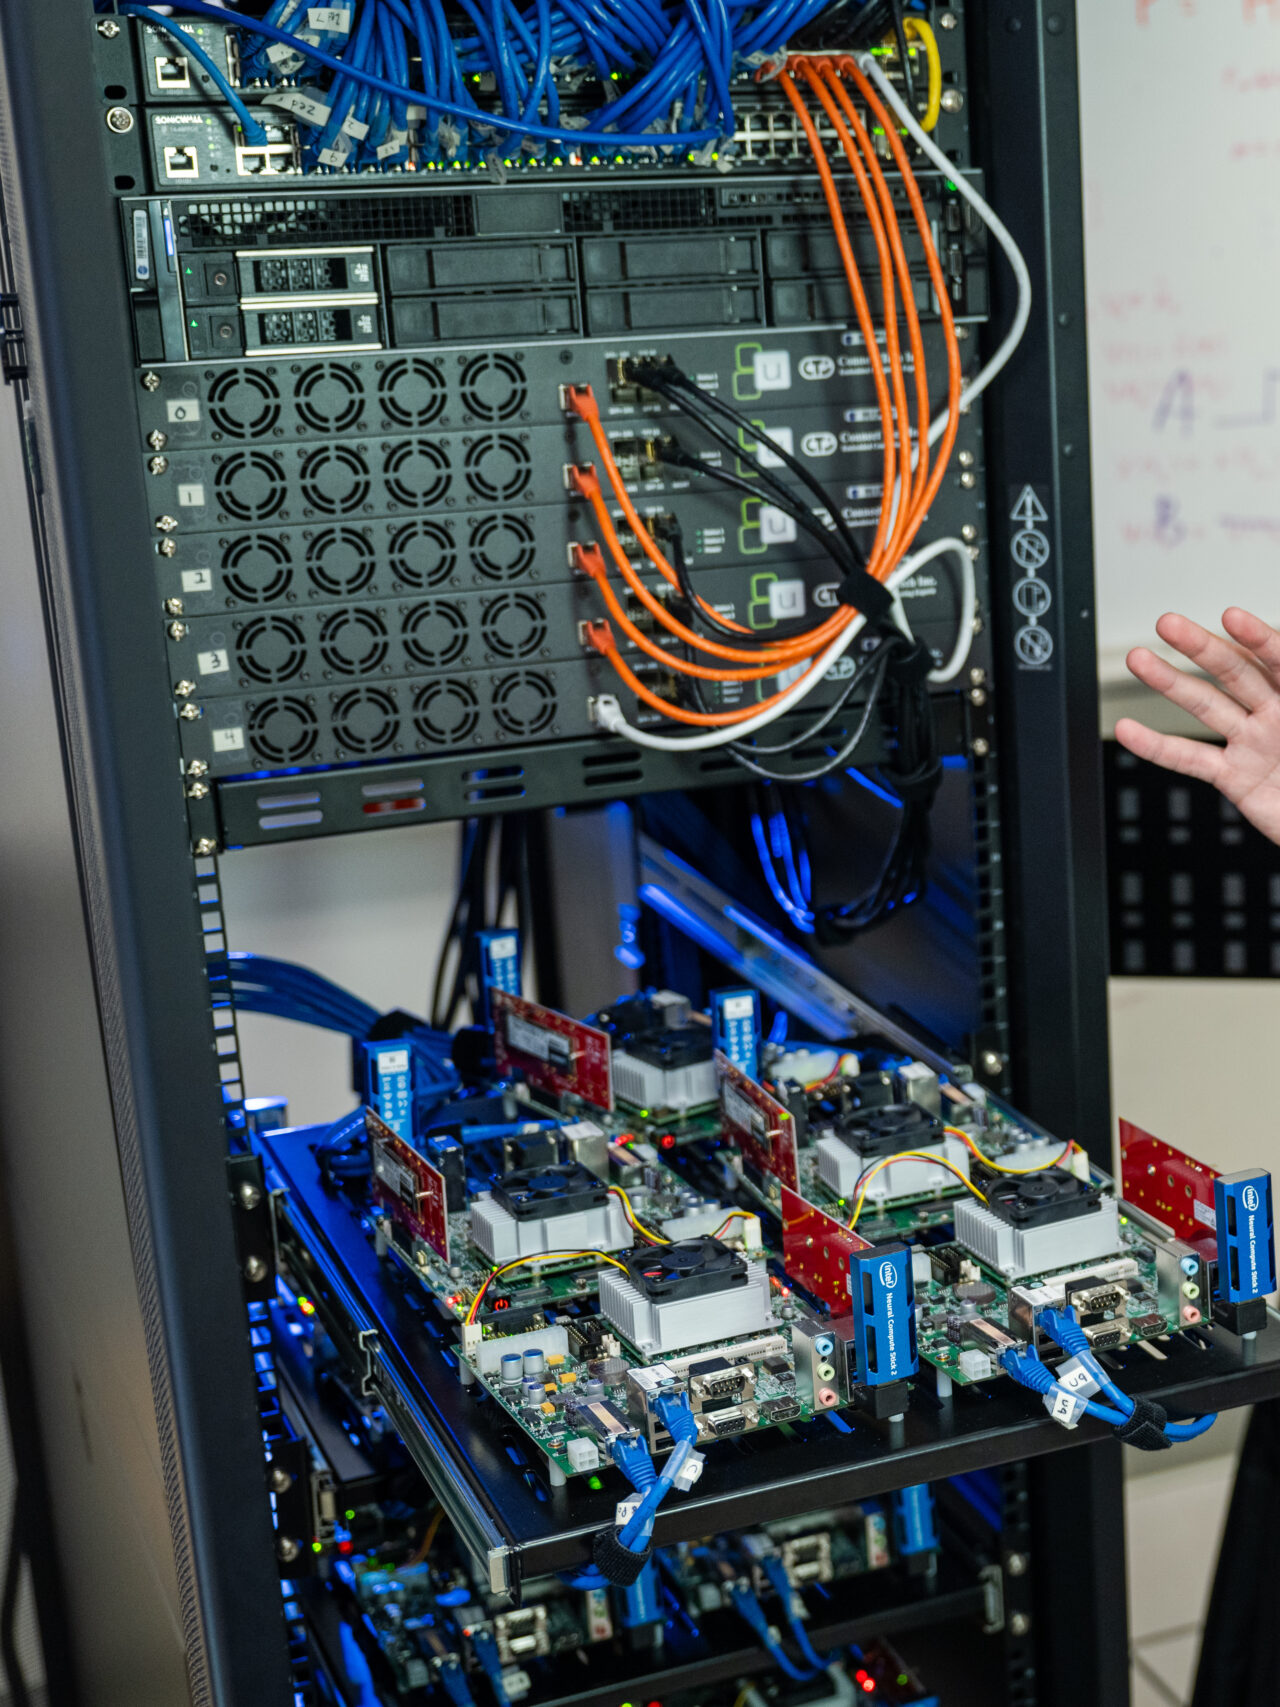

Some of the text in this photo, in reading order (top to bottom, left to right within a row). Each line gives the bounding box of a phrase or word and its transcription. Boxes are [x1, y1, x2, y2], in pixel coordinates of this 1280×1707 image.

[211, 652, 221, 669] 3
[1248, 1214, 1256, 1240] Neural
[1249, 1240, 1257, 1271] Compute
[885, 1292, 894, 1318] Neural
[887, 1319, 896, 1352] Compute
[889, 1351, 897, 1371] Stick
